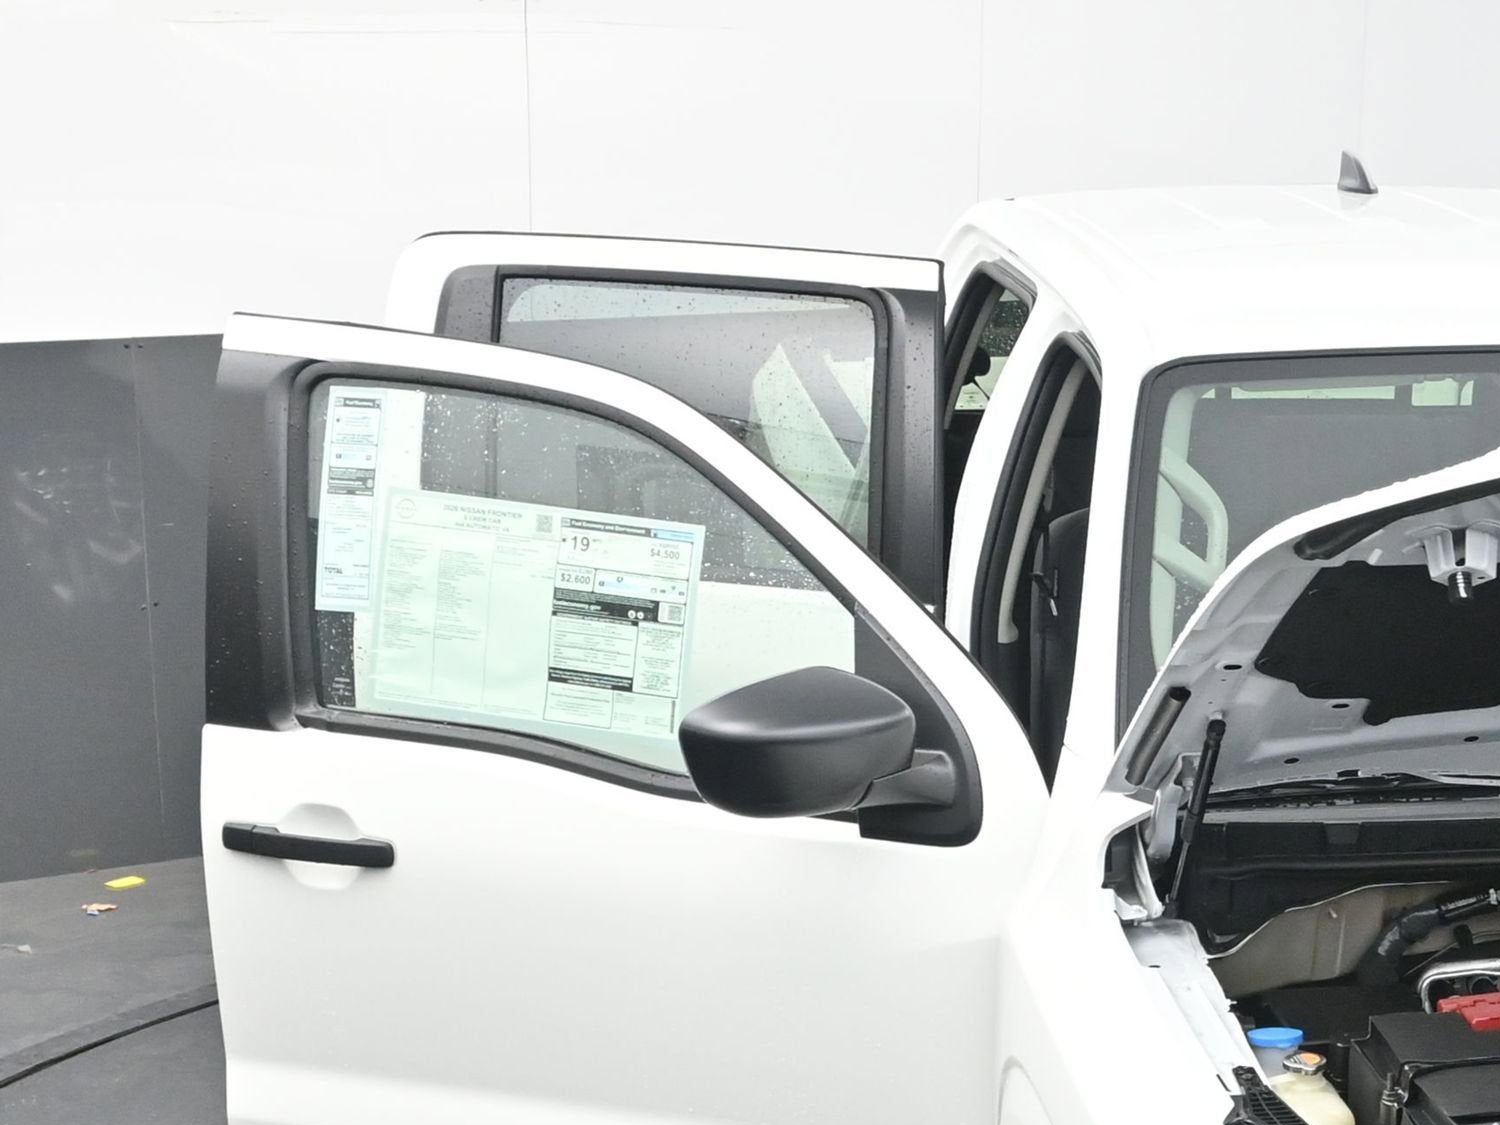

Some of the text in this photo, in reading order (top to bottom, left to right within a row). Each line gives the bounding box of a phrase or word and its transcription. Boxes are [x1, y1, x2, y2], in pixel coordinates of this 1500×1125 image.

[460, 506, 486, 515] NISSAN
[488, 509, 523, 519] FRONTIER
[571, 536, 591, 552] 19
